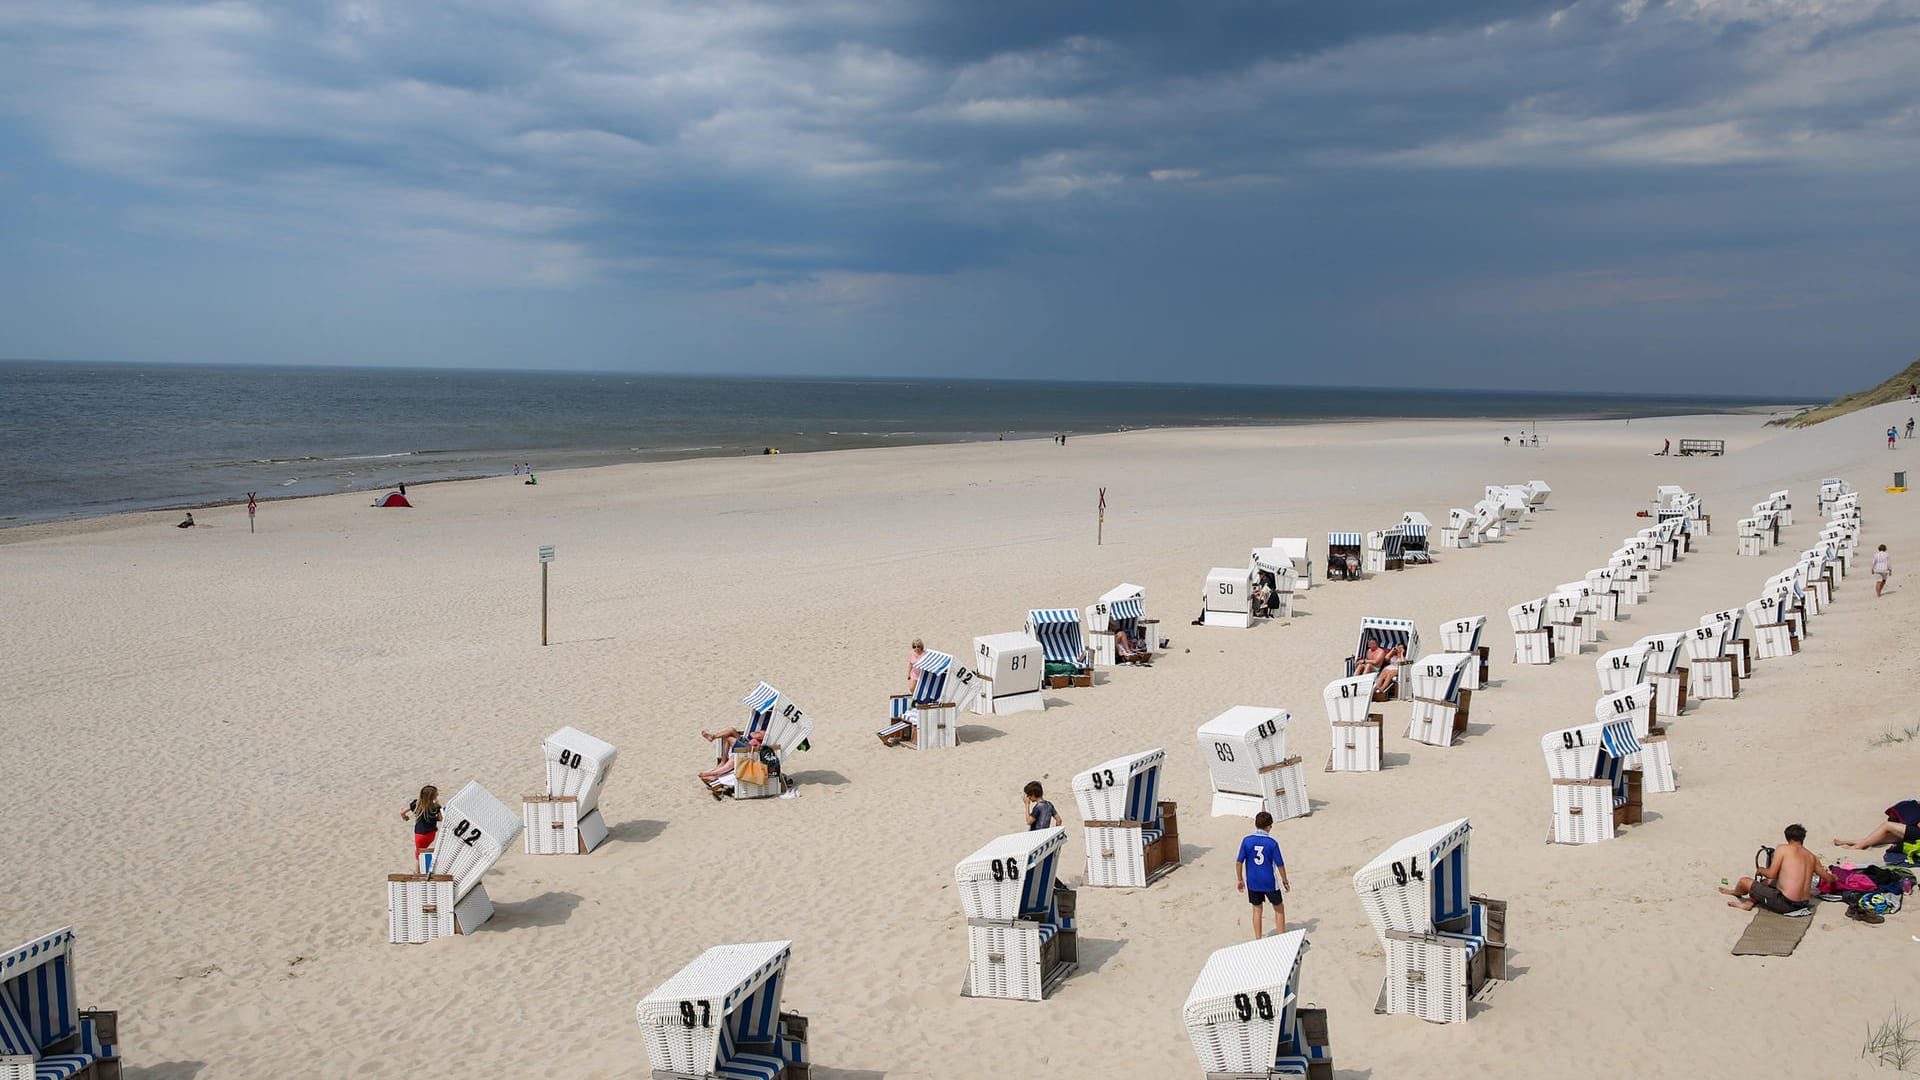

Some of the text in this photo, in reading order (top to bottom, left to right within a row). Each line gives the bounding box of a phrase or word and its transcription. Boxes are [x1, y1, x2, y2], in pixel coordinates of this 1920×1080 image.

[1219, 582, 1234, 595] 50
[1521, 603, 1535, 615] 54
[1558, 598, 1570, 608] 51
[1760, 597, 1775, 609] 52
[1715, 611, 1731, 623] 55
[1457, 621, 1471, 633] 57
[1696, 627, 1713, 641] 58
[981, 643, 990, 658] 81
[1011, 654, 1028, 671] 81
[1612, 655, 1630, 670] 84
[1426, 665, 1443, 678] 83
[1340, 683, 1359, 699] 87
[1613, 695, 1636, 714] 86
[1563, 729, 1585, 750] 91
[559, 748, 582, 770] 90
[1214, 741, 1235, 763] 89
[1091, 768, 1115, 791] 93
[1253, 845, 1265, 866] 3
[991, 856, 1019, 882] 96
[1391, 855, 1424, 887] 94
[679, 999, 711, 1029] 97
[1234, 991, 1274, 1022] 99
